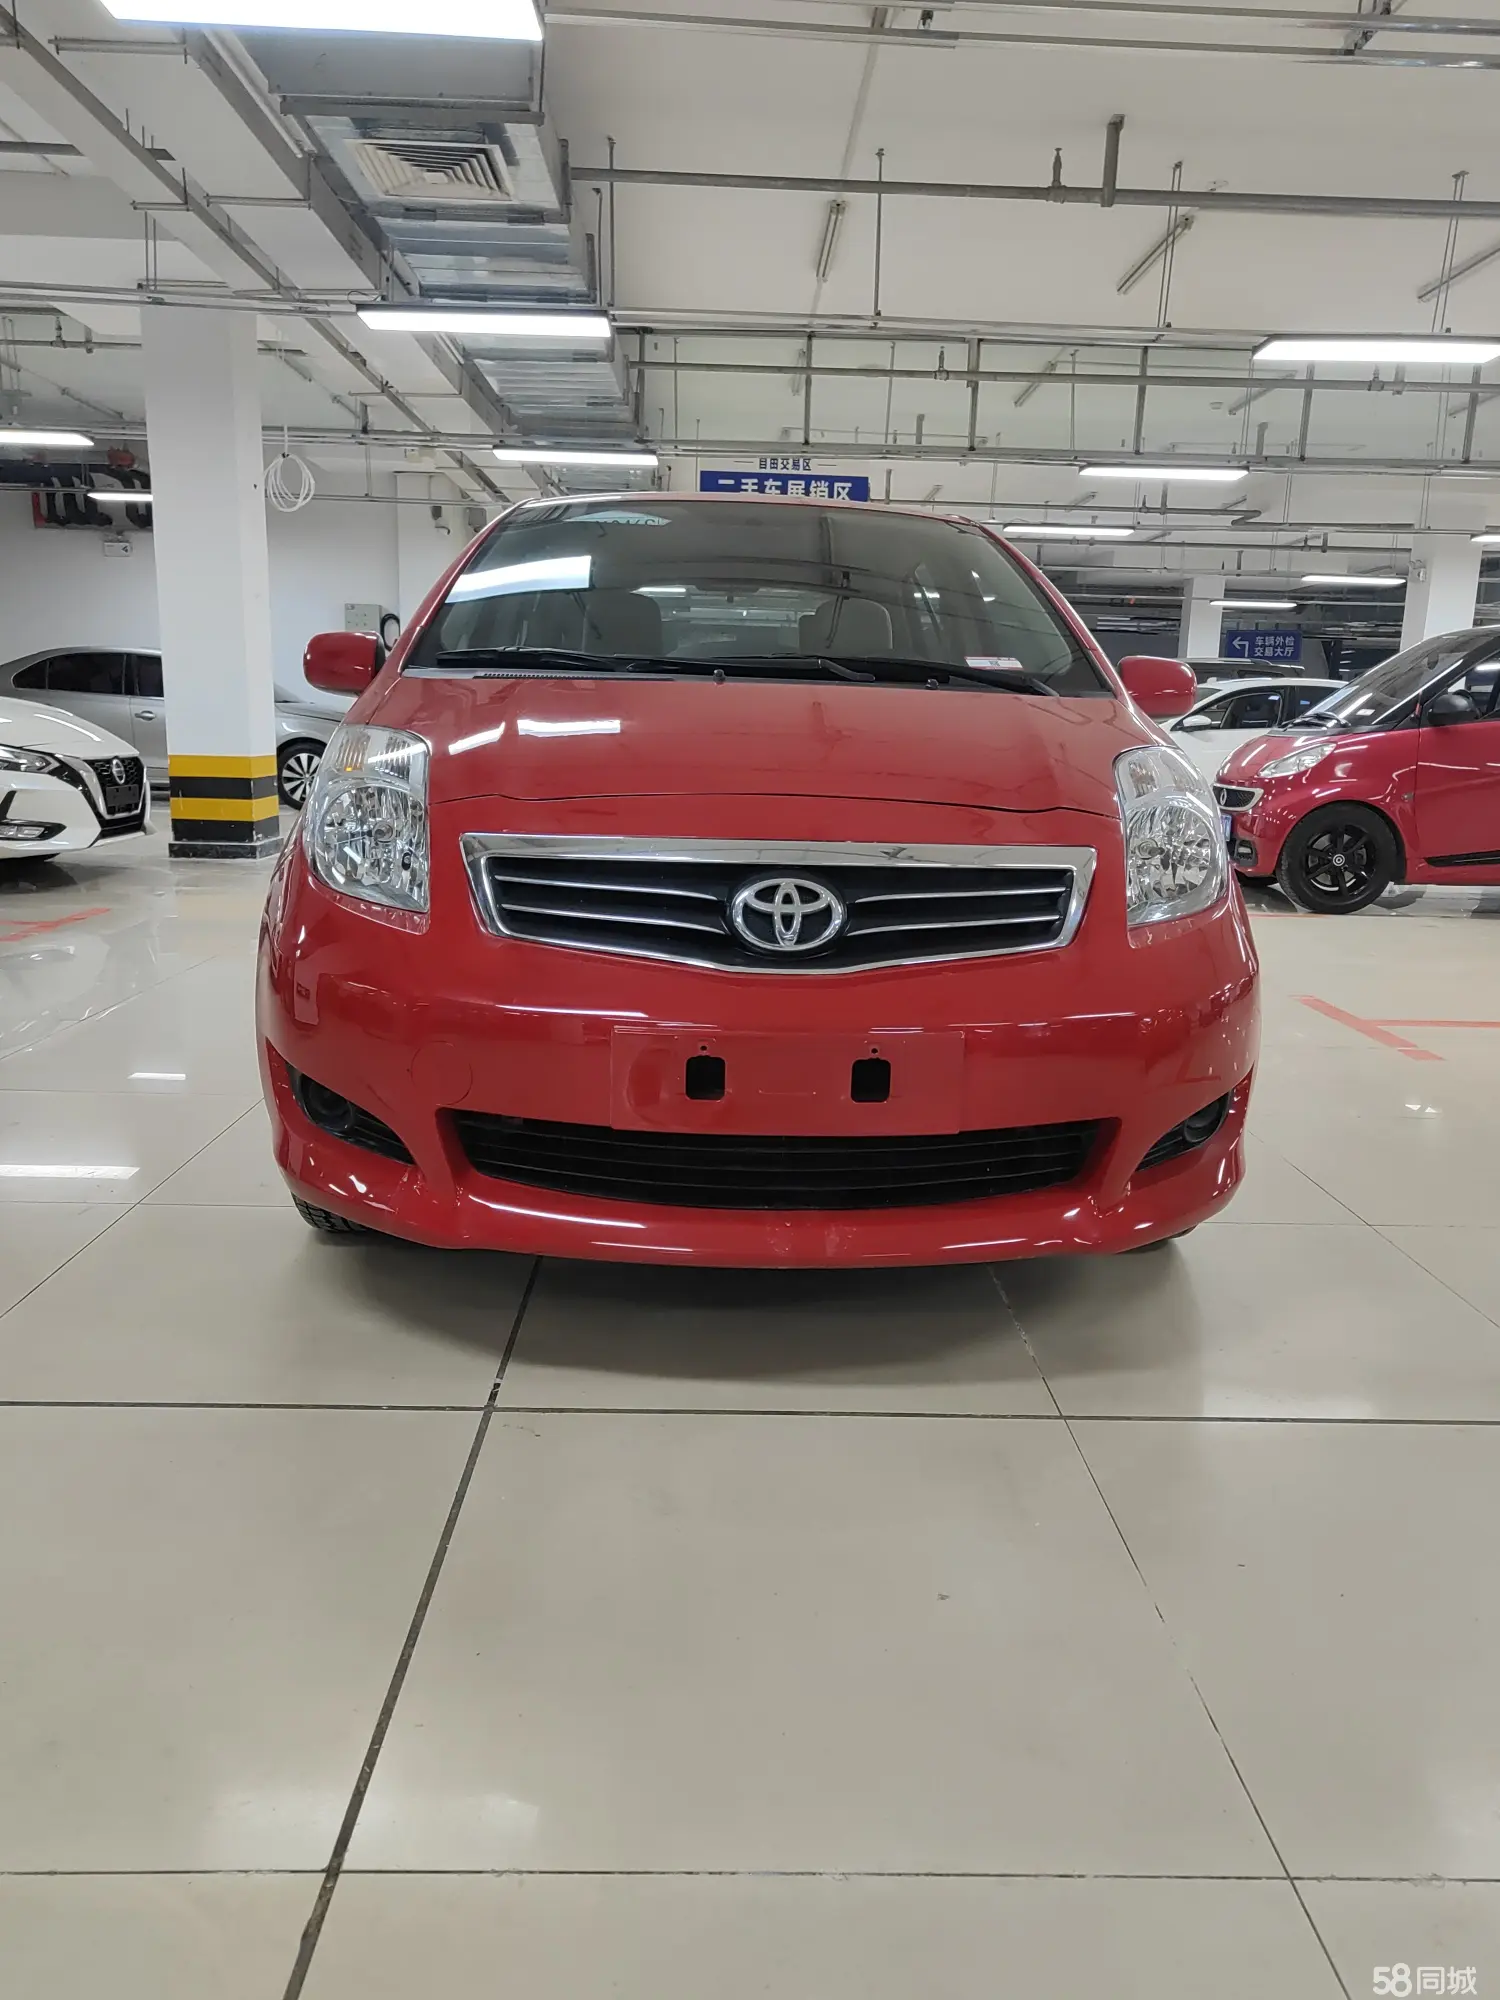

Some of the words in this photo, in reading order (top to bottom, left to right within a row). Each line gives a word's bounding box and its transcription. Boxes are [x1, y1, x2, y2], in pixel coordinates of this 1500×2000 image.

[1255, 636, 1295, 646] 车辆外检
[1254, 647, 1294, 657] 交易大厅
